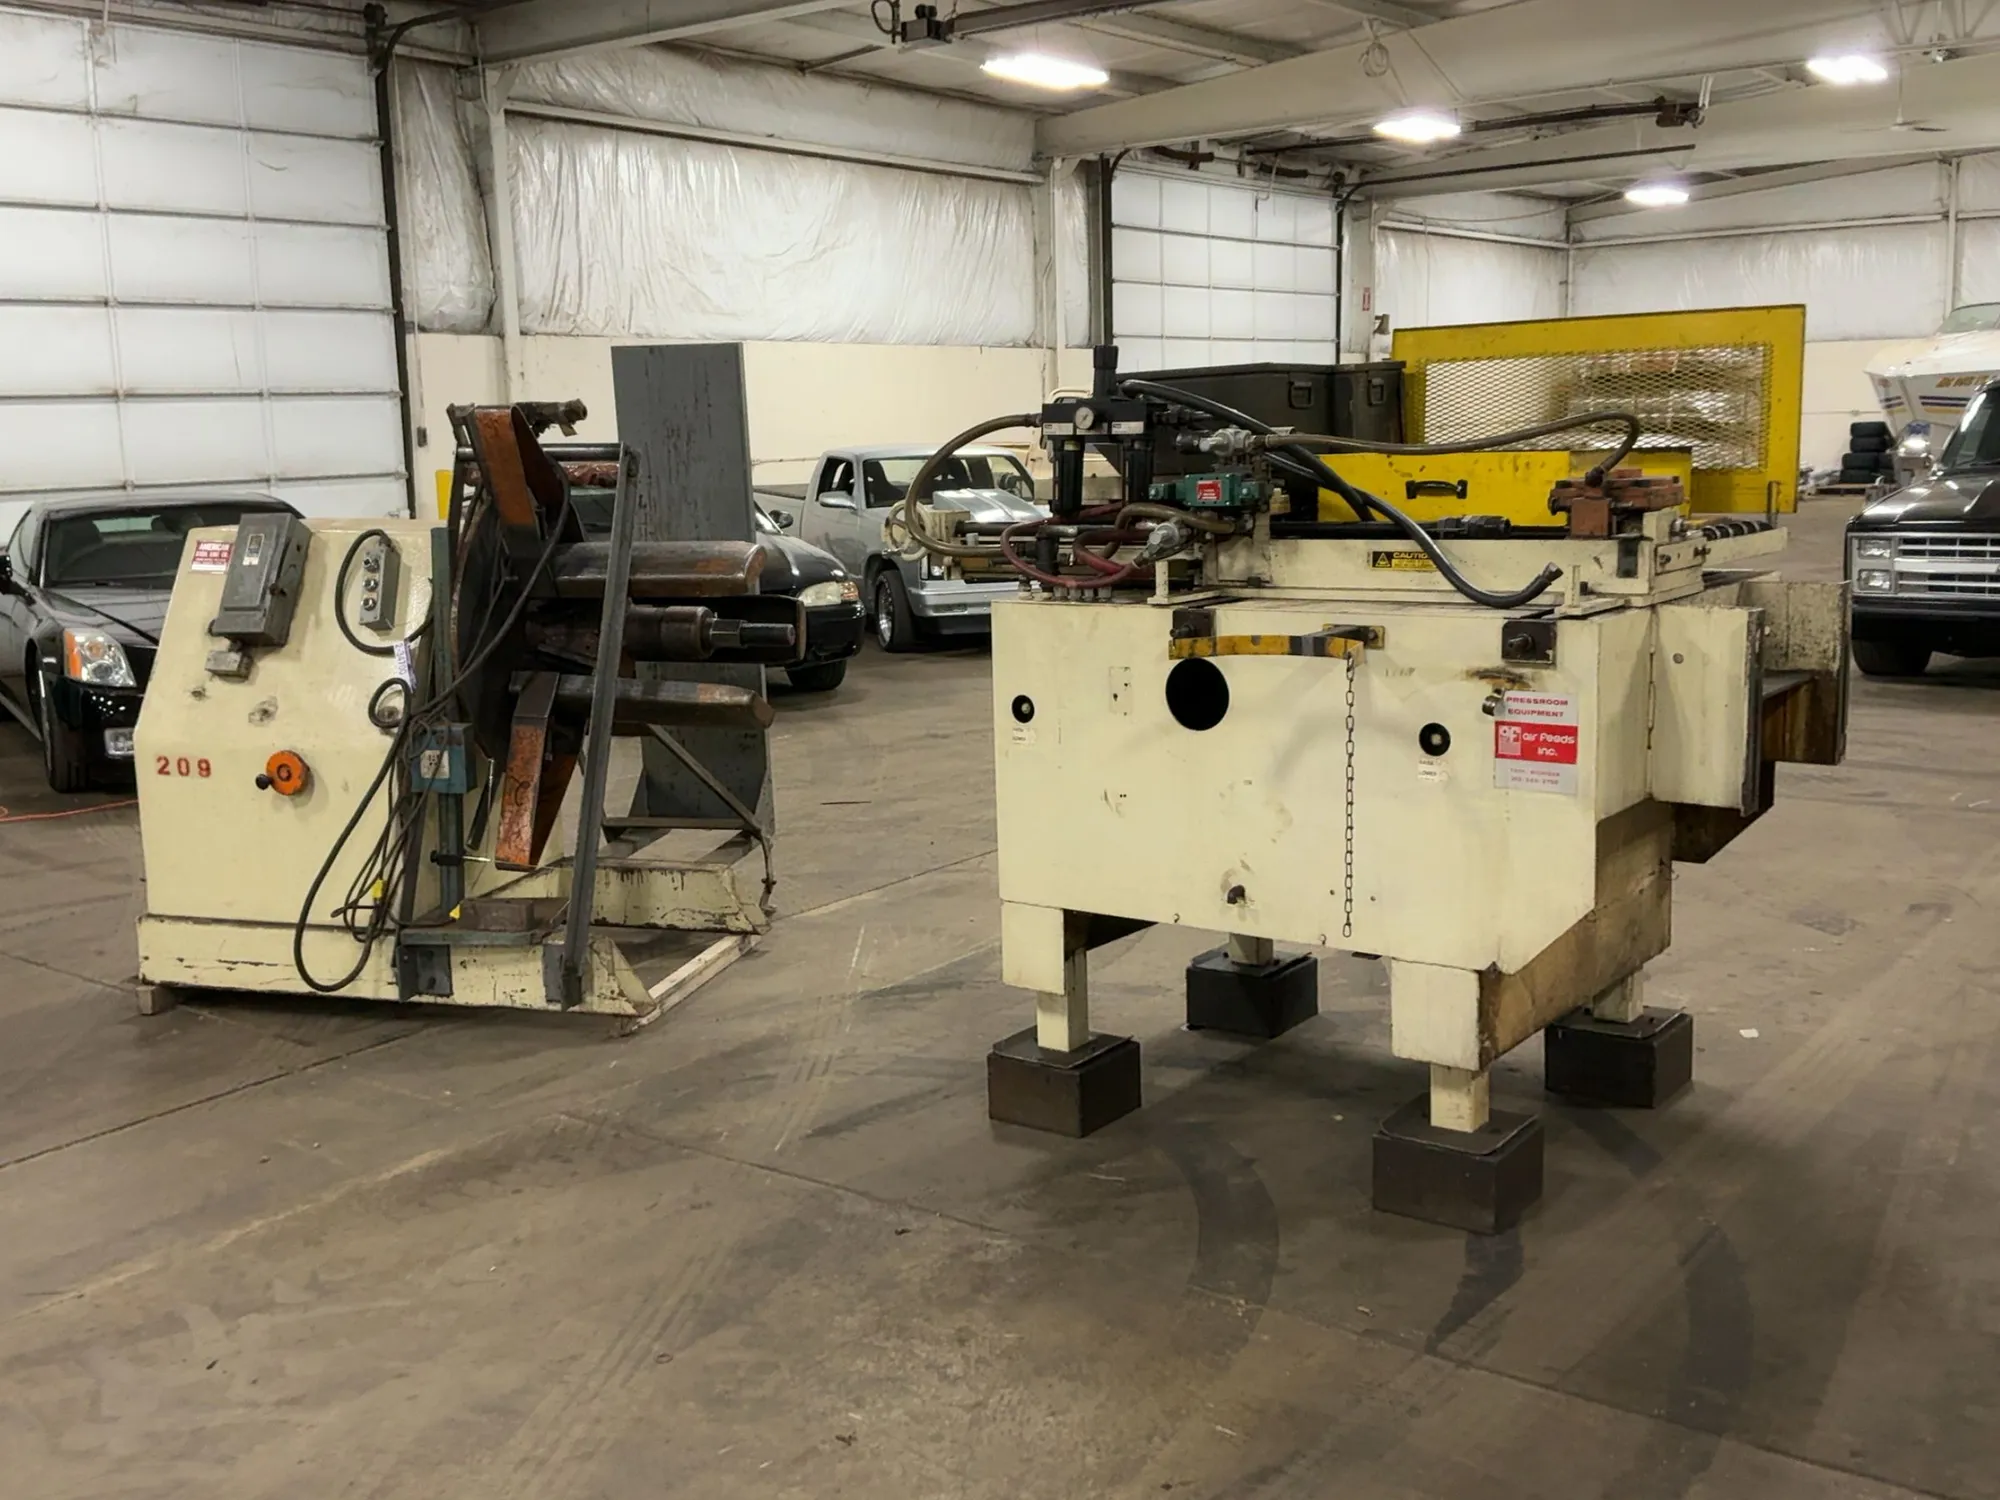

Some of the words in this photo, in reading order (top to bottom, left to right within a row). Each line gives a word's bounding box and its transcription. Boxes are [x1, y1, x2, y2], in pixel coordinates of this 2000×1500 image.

[1393, 551, 1429, 559] CAUTIO
[1506, 696, 1568, 706] PRESSROOM
[1508, 708, 1564, 717] EQUIPMENT
[1522, 732, 1537, 741] air
[156, 756, 211, 778] 209
